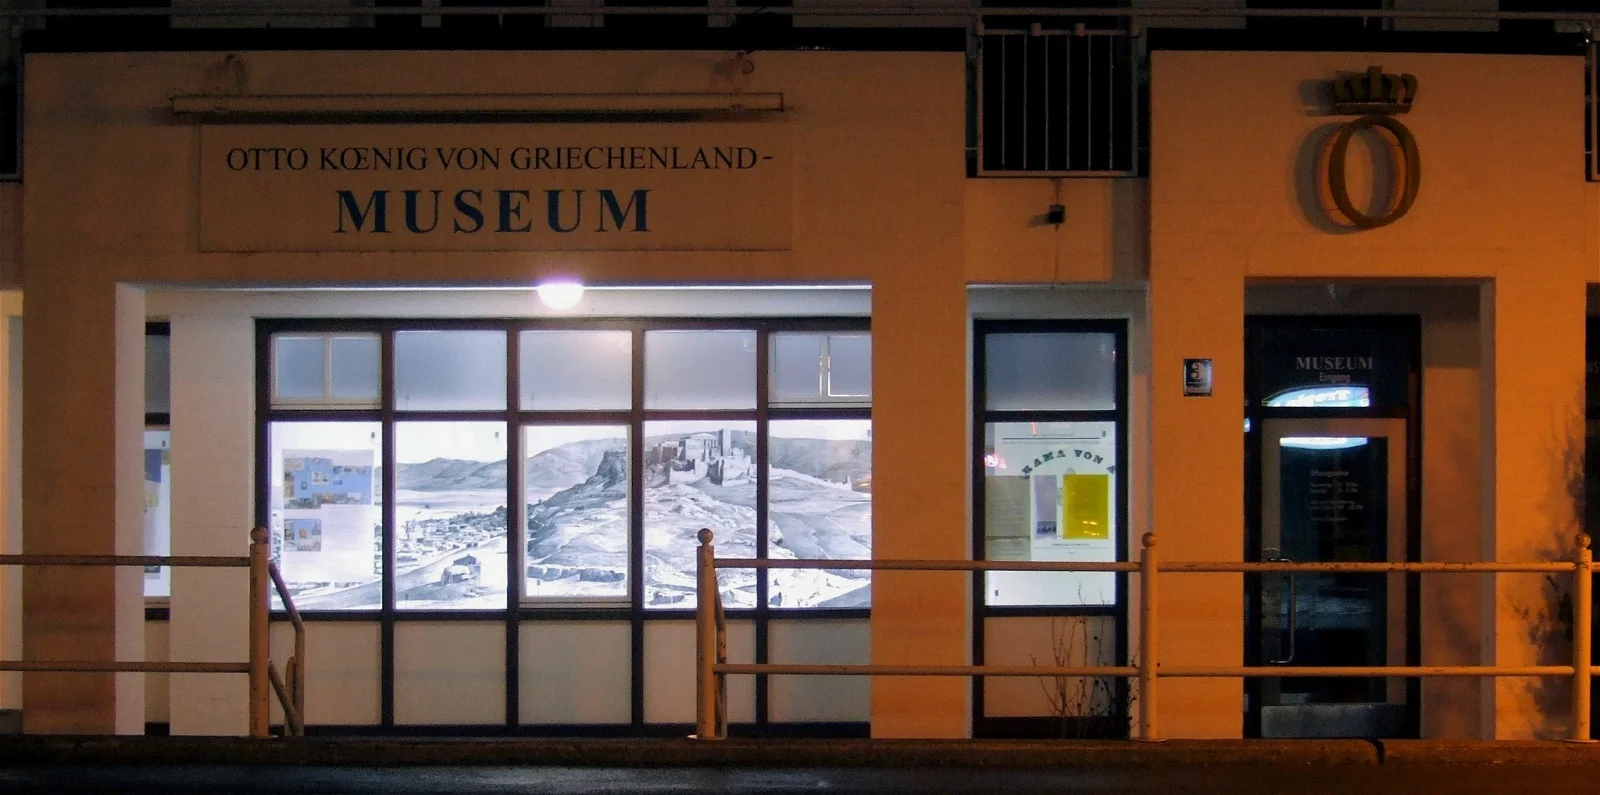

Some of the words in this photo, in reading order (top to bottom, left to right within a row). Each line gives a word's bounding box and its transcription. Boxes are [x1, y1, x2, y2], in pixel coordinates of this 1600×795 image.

[226, 148, 309, 172] OTTO
[319, 147, 429, 172] KŒNIG
[436, 148, 502, 172] VON
[335, 188, 651, 235] MUSEUM
[1190, 362, 1206, 380] 3
[1295, 356, 1374, 370] MUSEUM
[1073, 448, 1104, 465] VON
